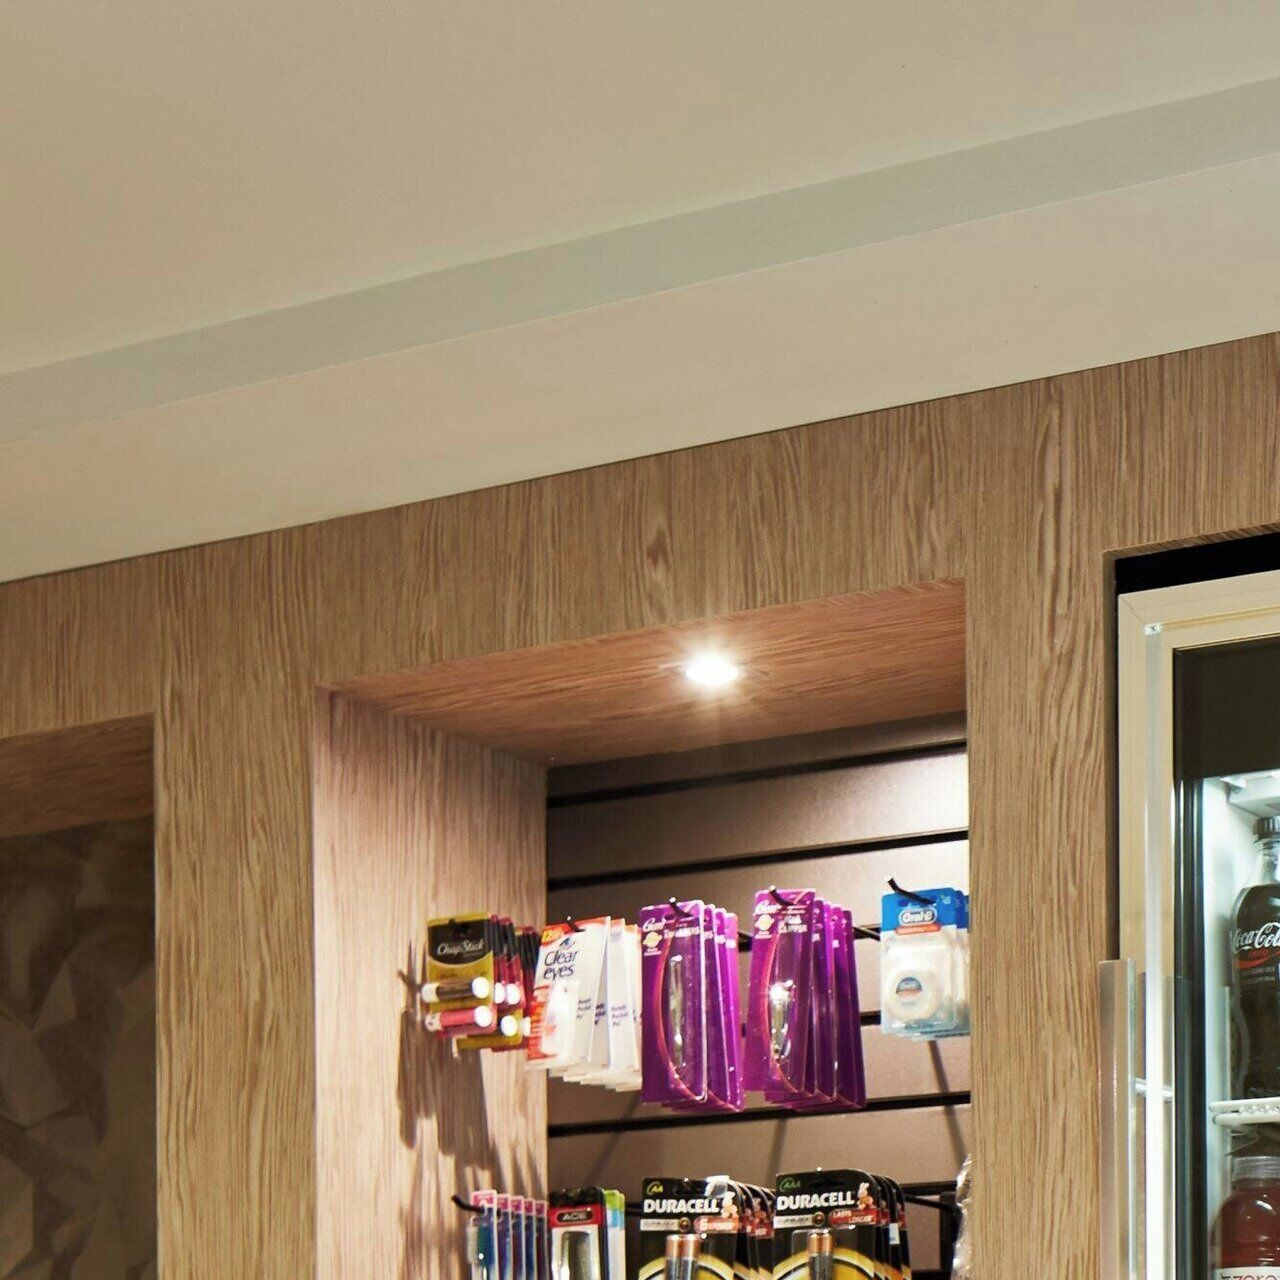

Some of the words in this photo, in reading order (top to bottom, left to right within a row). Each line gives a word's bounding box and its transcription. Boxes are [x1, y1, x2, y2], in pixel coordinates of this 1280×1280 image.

[437, 938, 485, 956] ChapStick
[543, 949, 579, 967] Clear
[543, 964, 574, 980] eyes
[643, 1198, 719, 1213] DURACELL
[776, 1191, 855, 1211] DURACELL
